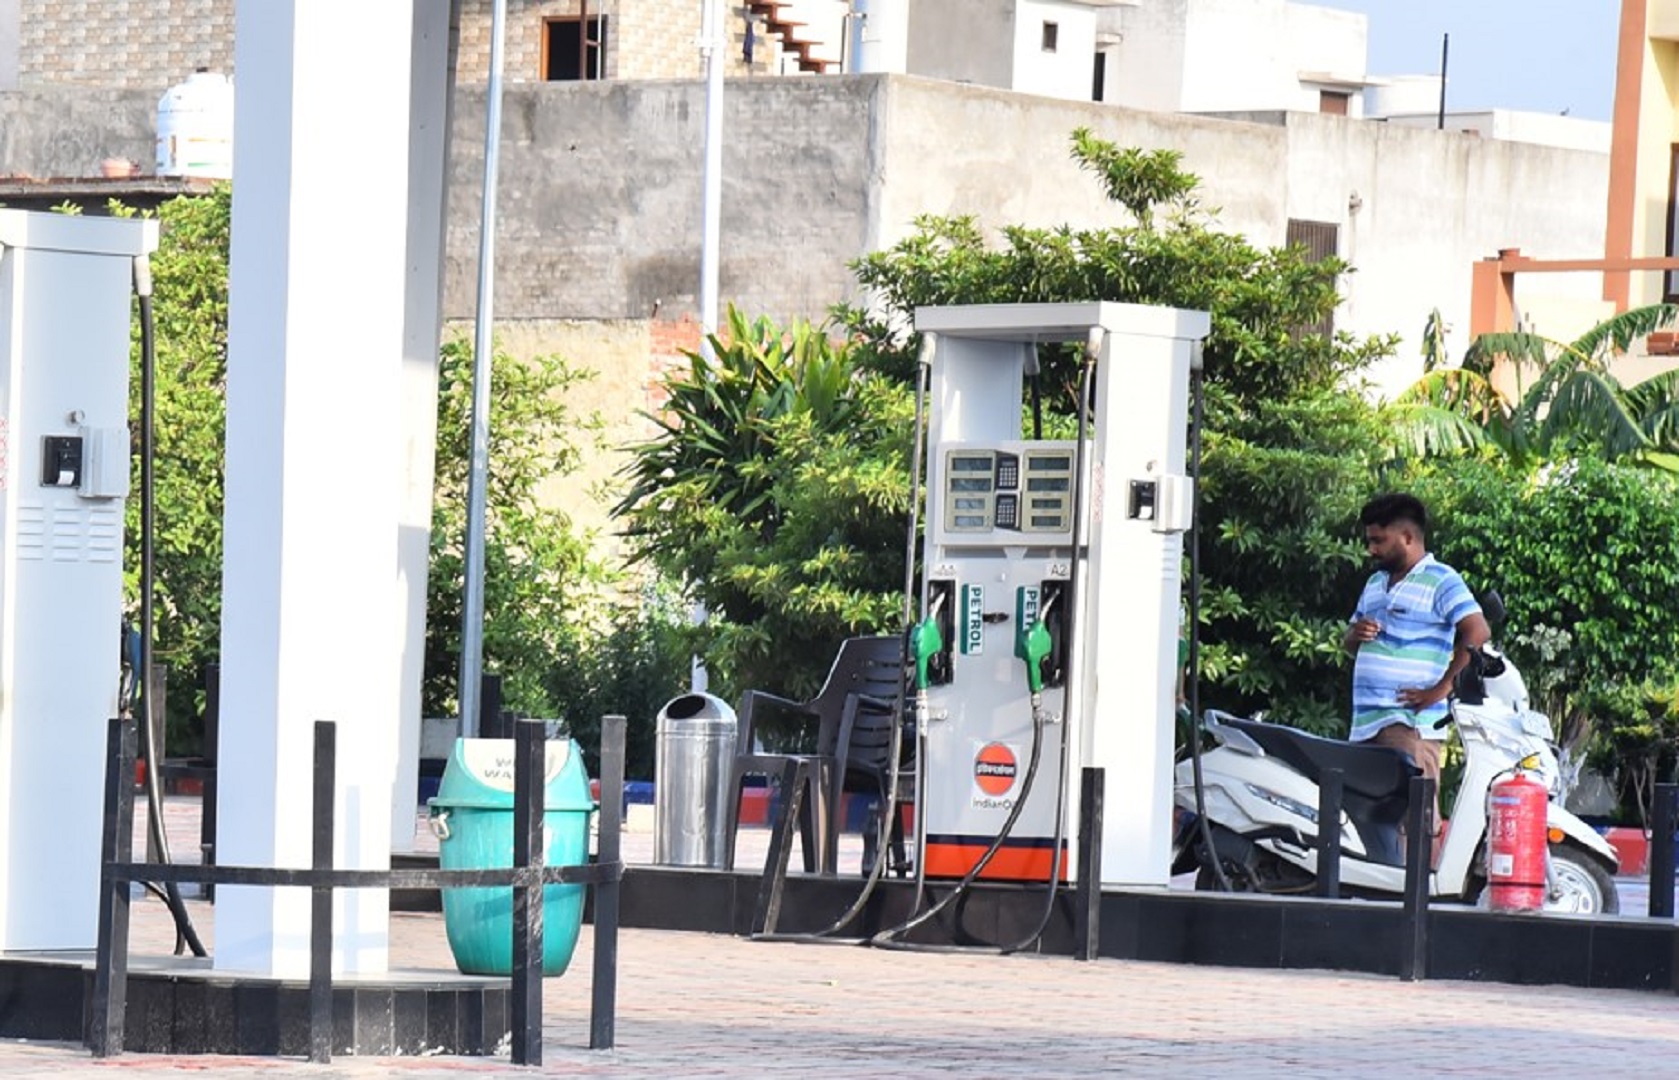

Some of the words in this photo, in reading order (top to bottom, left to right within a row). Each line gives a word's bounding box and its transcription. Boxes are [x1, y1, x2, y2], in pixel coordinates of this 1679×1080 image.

[1051, 564, 1068, 577] A2
[970, 586, 982, 651] PETROL
[1026, 590, 1038, 629] PET
